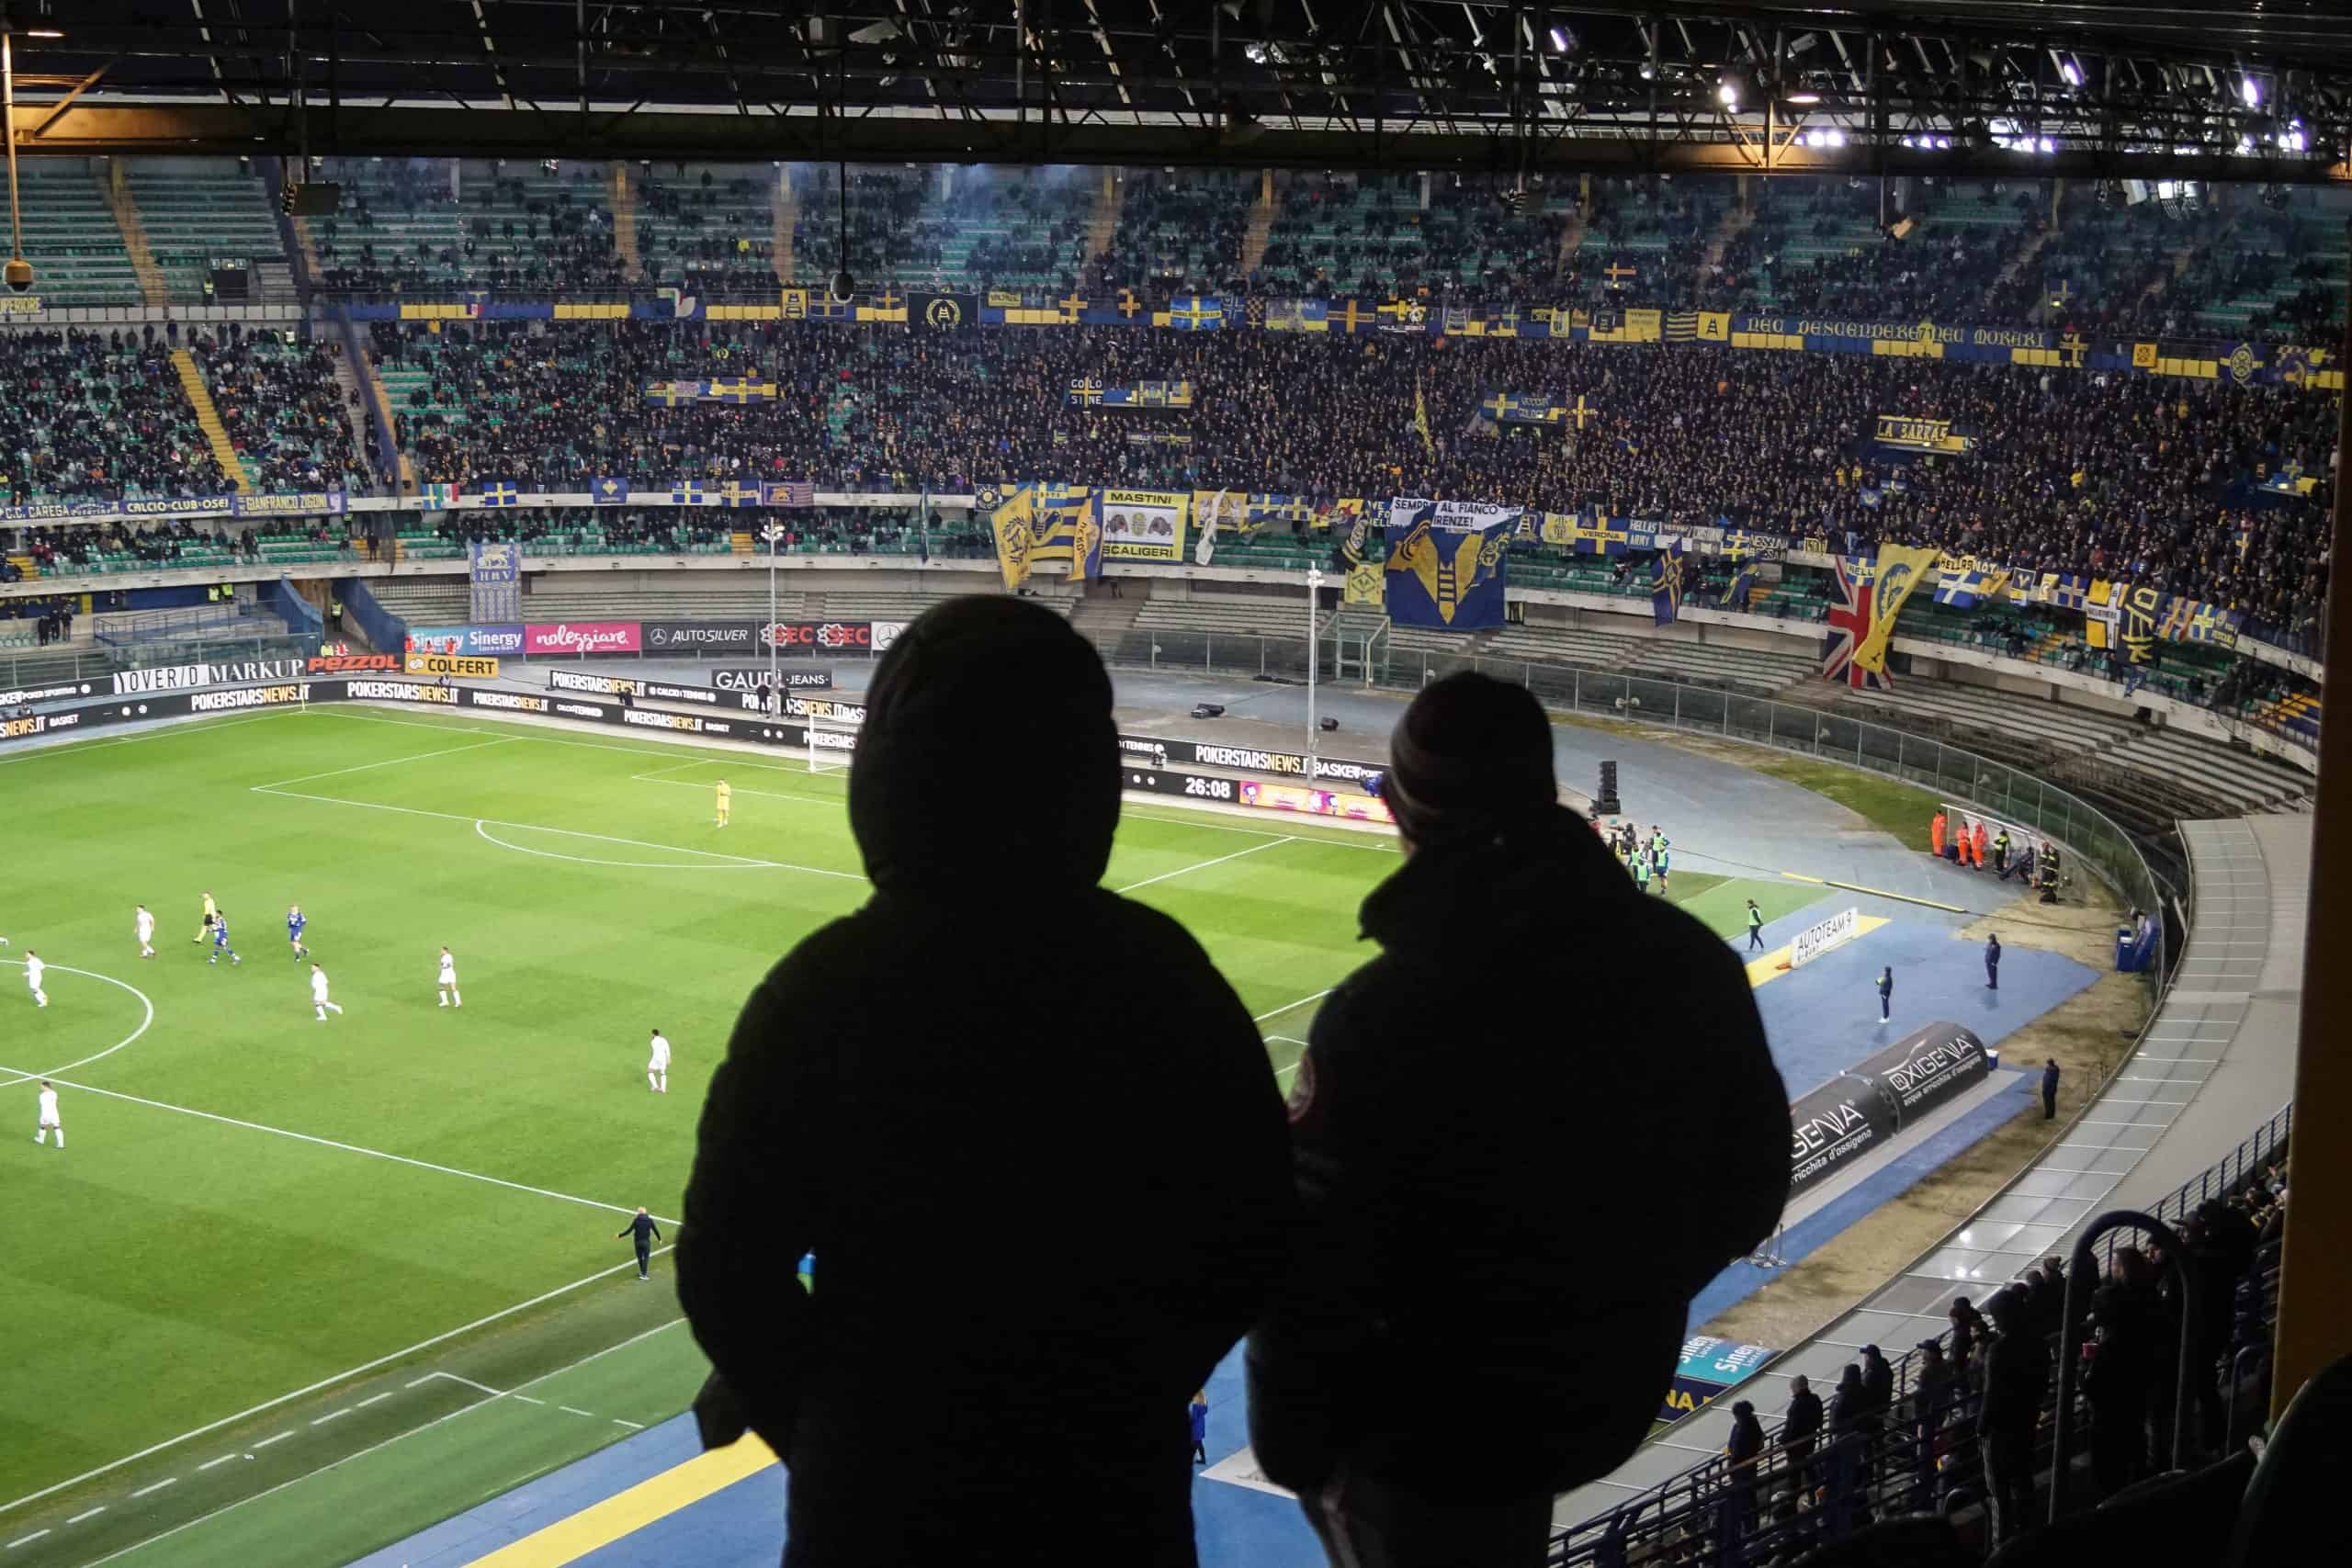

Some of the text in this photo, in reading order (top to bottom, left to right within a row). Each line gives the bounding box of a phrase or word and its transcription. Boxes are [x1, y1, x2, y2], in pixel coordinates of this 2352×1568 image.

[1111, 493, 1171, 504] MASTINI
[1459, 503, 1498, 515] FIANCO
[1102, 545, 1173, 558] SCALIGERI
[469, 630, 522, 648] Sinergy
[672, 629, 748, 643] AUTOSILVER
[209, 660, 304, 682] MARKUP
[428, 659, 494, 674] COLFERT
[191, 684, 311, 711] POKERSTARSNEWS.IT
[347, 682, 460, 704] POKERSTARSNEWS.IT
[473, 692, 548, 713] POKERSTARSNEWS.IT
[624, 710, 703, 731] POKERSTARSNEWS.IT
[1185, 777, 1231, 799] 26:08
[1828, 1128, 1872, 1161] d'ossigeno
